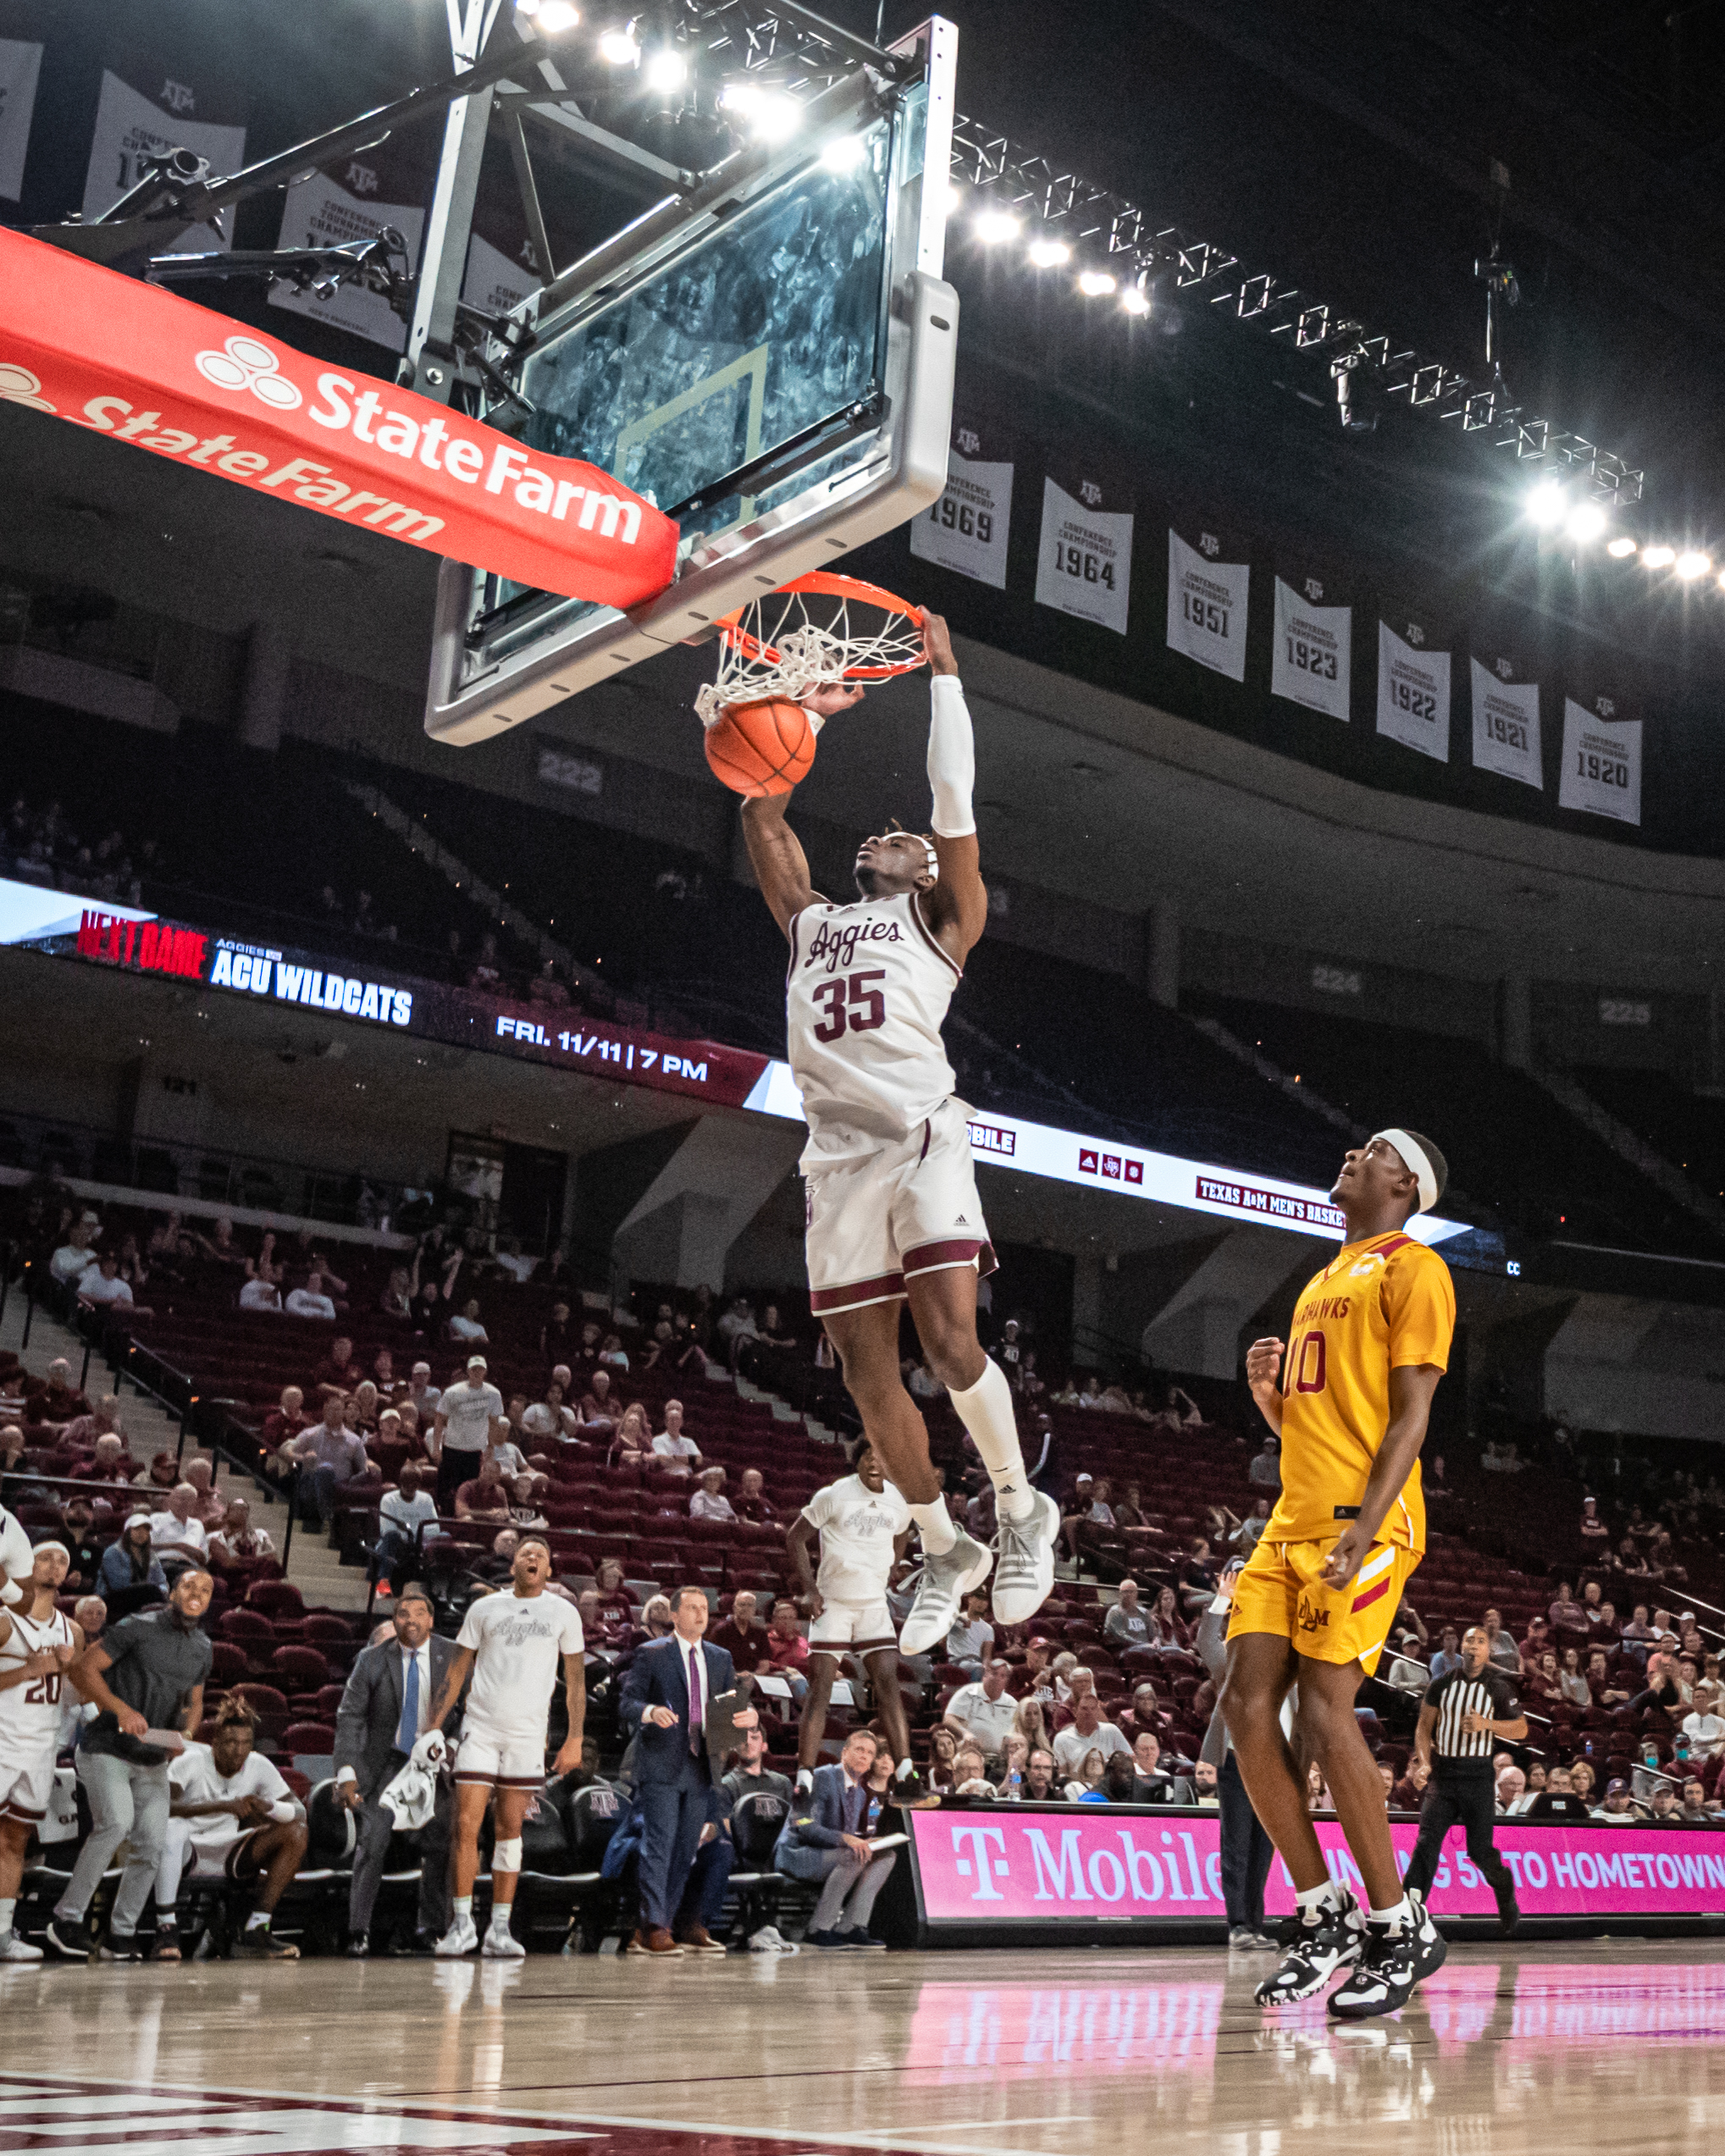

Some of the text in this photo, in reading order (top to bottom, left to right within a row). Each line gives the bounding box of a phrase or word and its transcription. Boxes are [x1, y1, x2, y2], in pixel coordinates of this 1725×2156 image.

[309, 372, 643, 545] State Farm
[259, 457, 445, 541] Farm
[946, 482, 996, 510] AMPIONSHIP
[947, 473, 991, 498] NFERENCE
[931, 498, 992, 544] 1969
[1056, 542, 1115, 591] 1964
[1183, 592, 1229, 639] 1951
[1286, 637, 1337, 680] 1923
[1390, 678, 1437, 722] 1922
[1486, 712, 1529, 752] 1921
[539, 752, 601, 793] 222
[1577, 751, 1628, 788] 1920
[77, 909, 209, 980] NEXT GAME
[804, 917, 905, 973] Aggies
[210, 948, 413, 1026] ACU WILDCATS
[812, 969, 886, 1043] 35
[496, 1015, 550, 1047] FRI.
[557, 1031, 622, 1063] 11/11
[639, 1048, 659, 1069] 7
[662, 1053, 708, 1081] PM
[1200, 1180, 1346, 1228] TEXAS A&M MEN'S BASKE
[1283, 1330, 1326, 1400] 10
[25, 1672, 62, 1704] 20
[951, 1826, 1010, 1900] T
[1456, 1850, 1490, 1888] 5
[1501, 1849, 1548, 1888] TO
[1551, 1851, 1725, 1889] HOMETOWN
